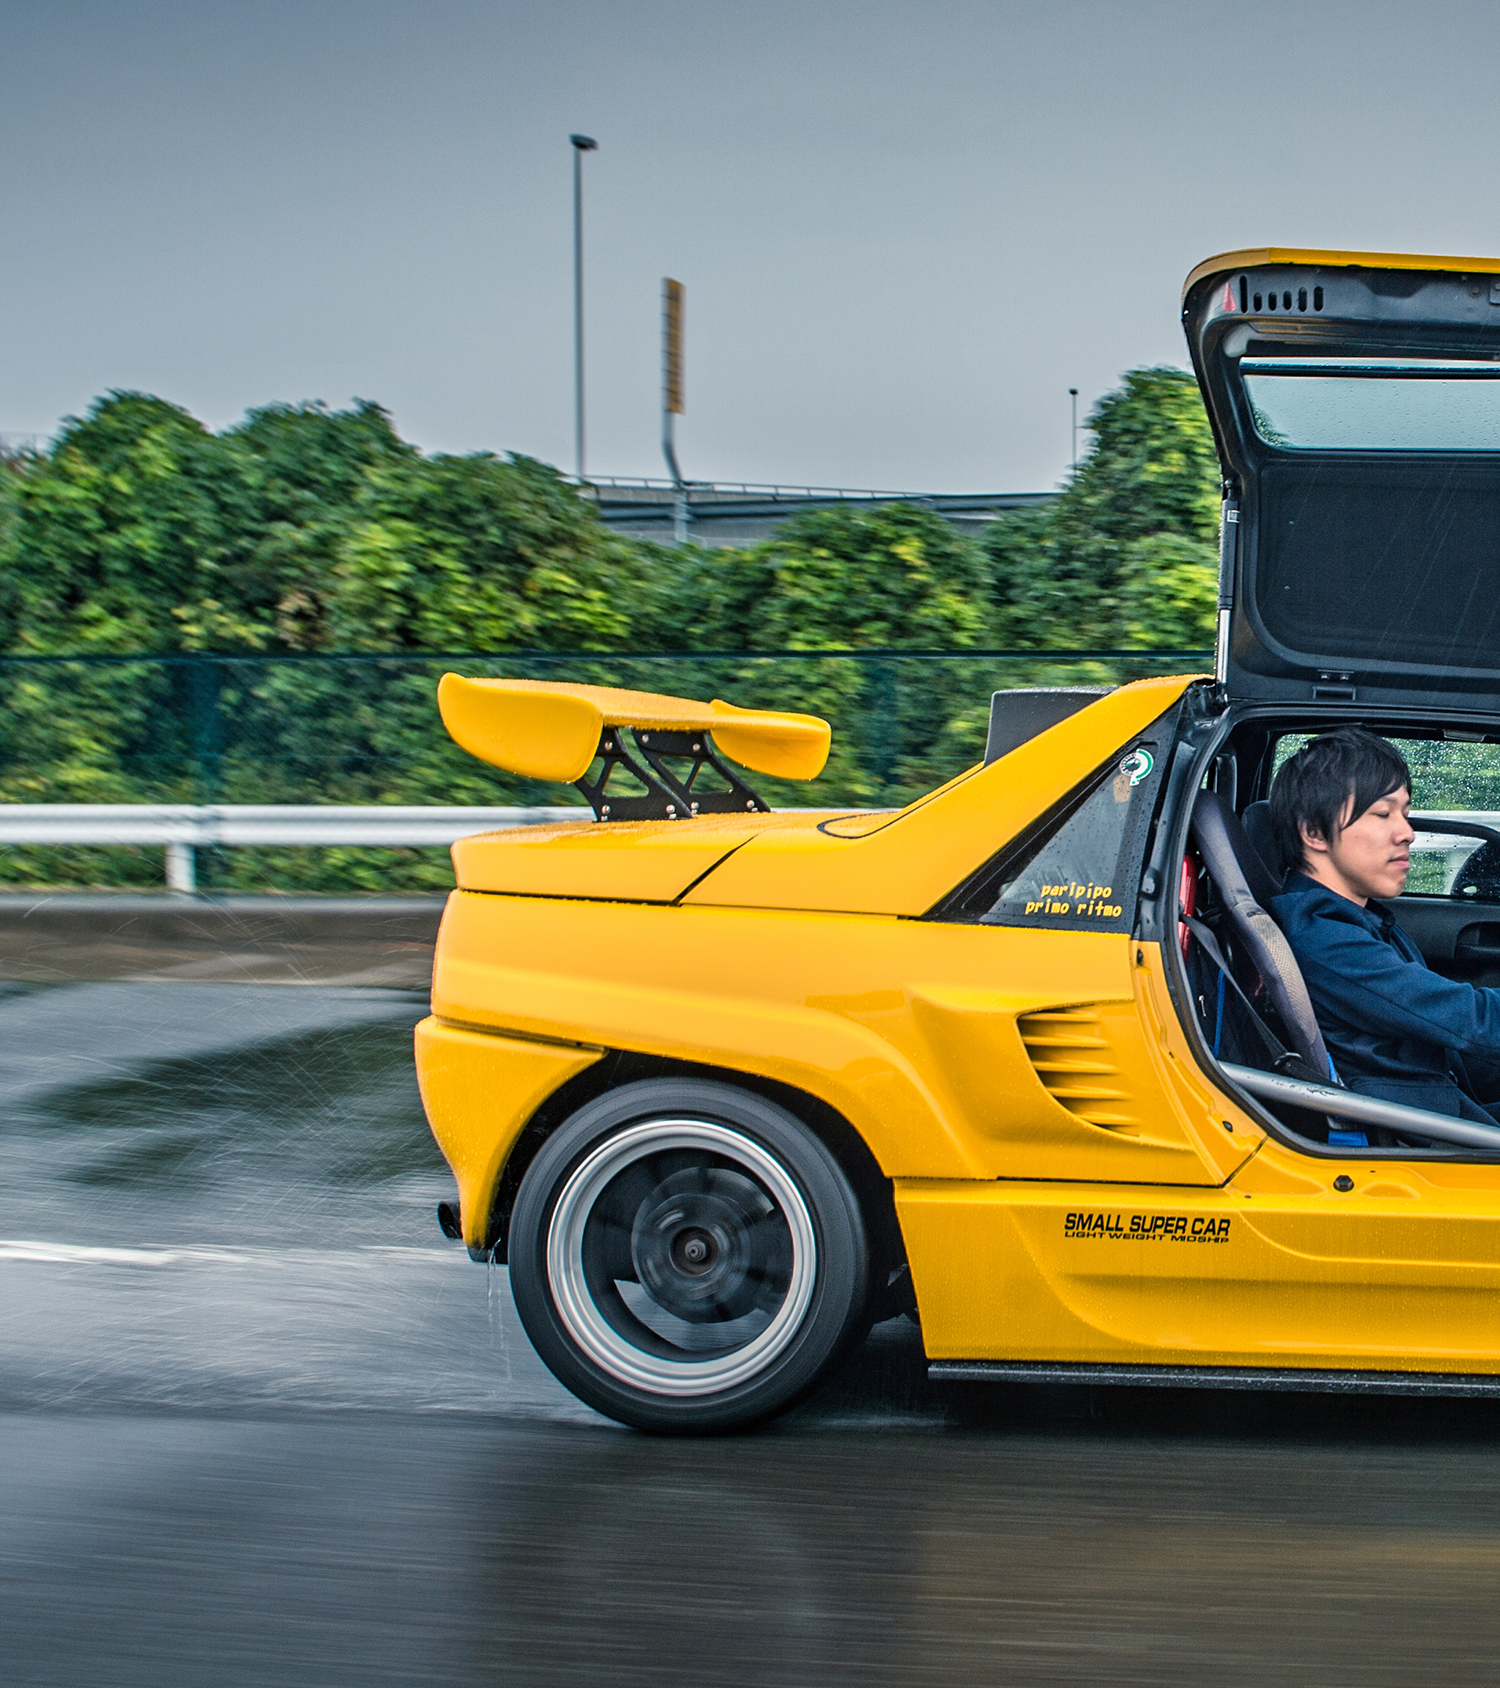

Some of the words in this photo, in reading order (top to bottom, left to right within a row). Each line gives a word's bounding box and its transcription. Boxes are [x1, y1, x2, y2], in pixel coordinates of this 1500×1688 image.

[1041, 881, 1112, 899] paripipo
[1024, 898, 1070, 915] primo
[1076, 900, 1122, 917] ritmo
[1064, 1213, 1124, 1232] SMALL
[1129, 1215, 1188, 1235] SUPER
[1191, 1218, 1231, 1236] CAR
[1171, 1234, 1229, 1244] MIDSHIP
